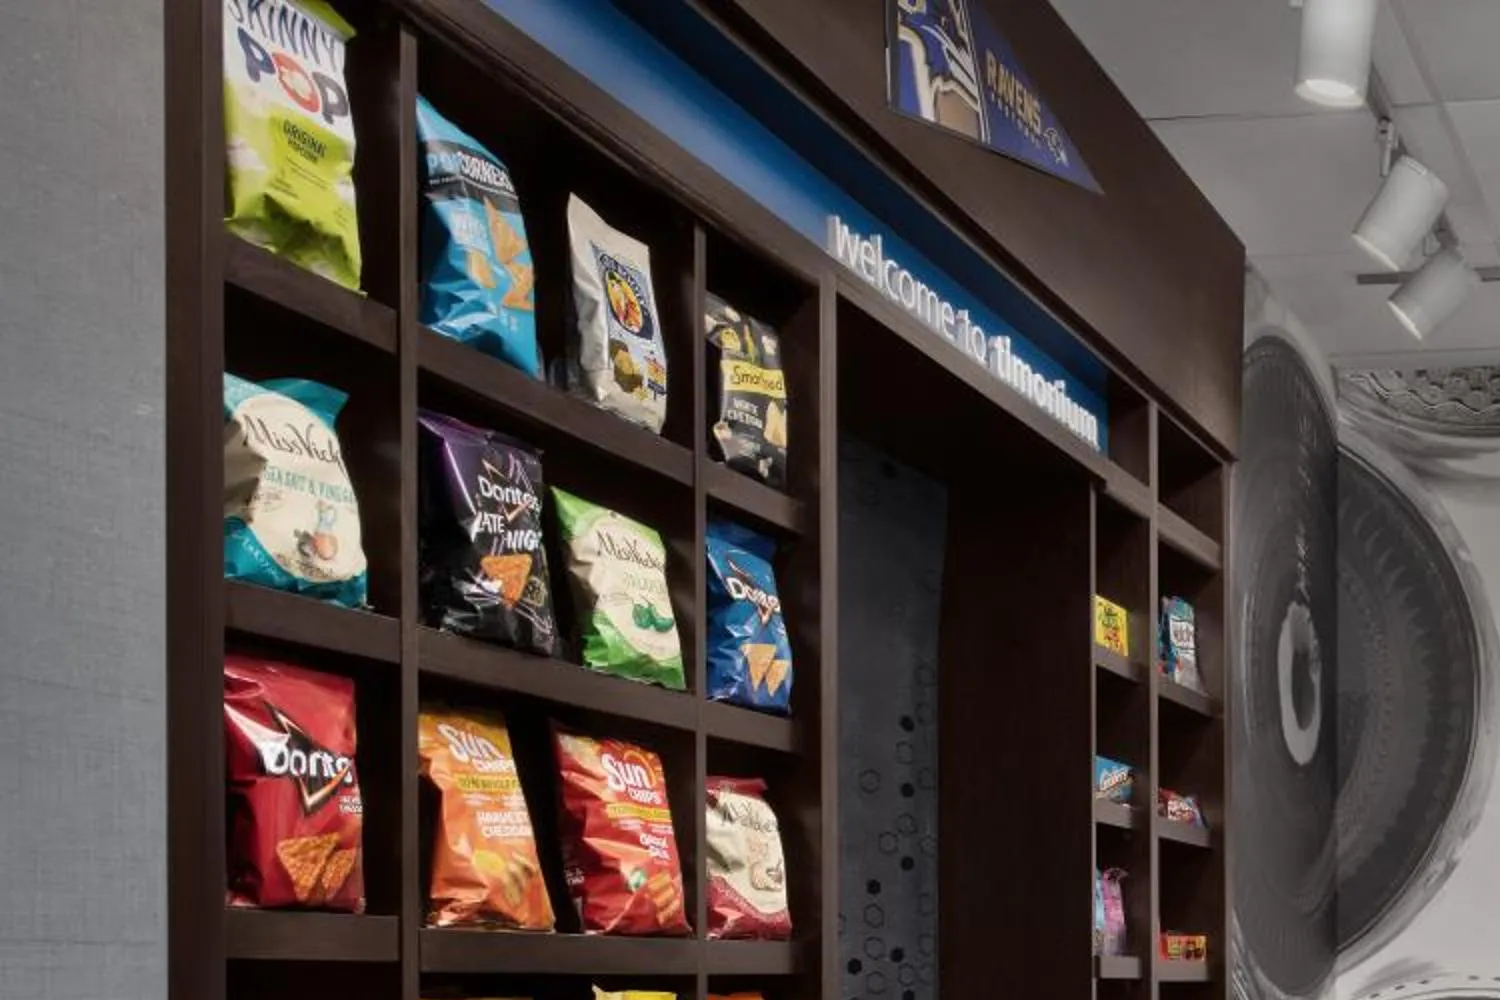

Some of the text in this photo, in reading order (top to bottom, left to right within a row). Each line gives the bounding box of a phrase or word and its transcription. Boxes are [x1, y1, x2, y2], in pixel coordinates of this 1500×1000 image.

[237, 26, 350, 125] POP
[828, 215, 956, 342] welcome
[957, 309, 989, 368] to
[601, 753, 653, 793] Sun
